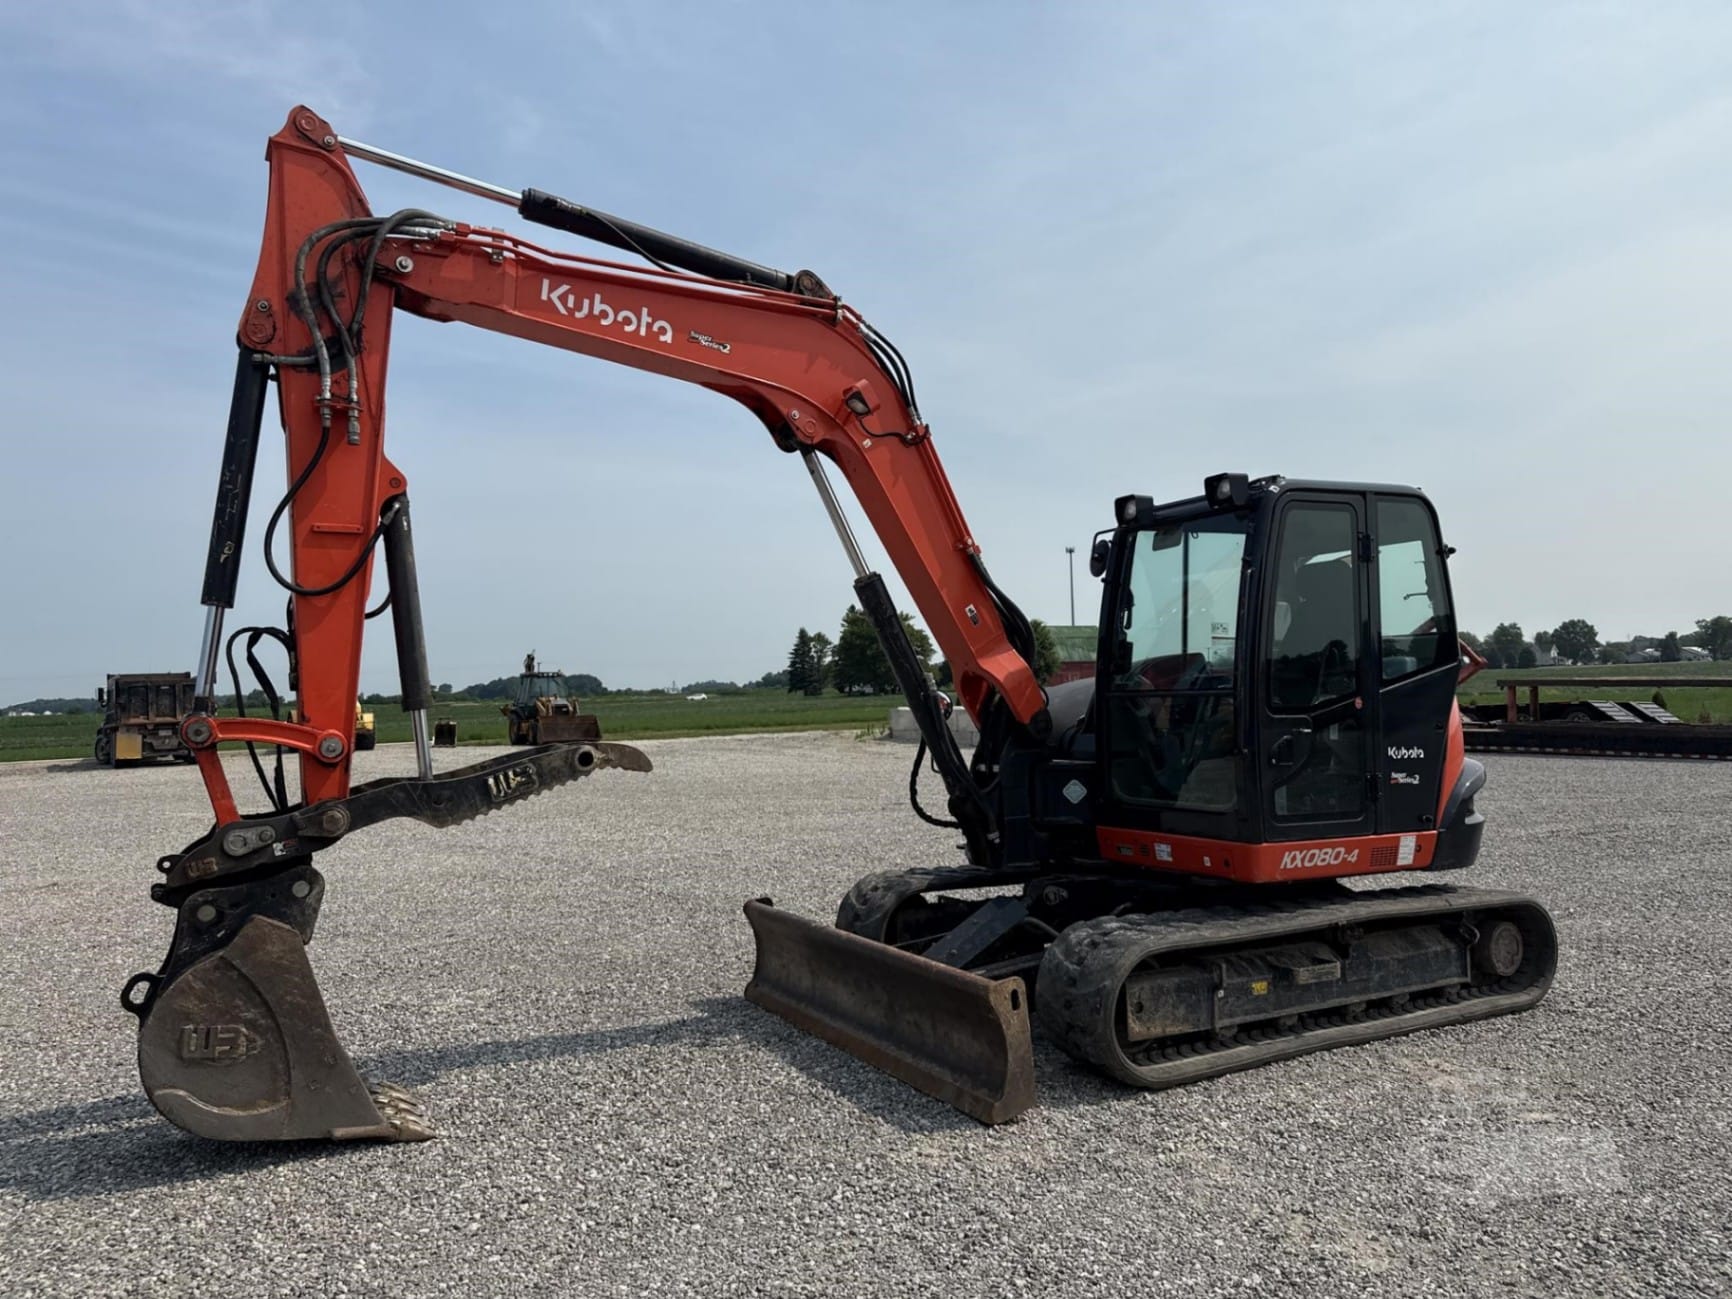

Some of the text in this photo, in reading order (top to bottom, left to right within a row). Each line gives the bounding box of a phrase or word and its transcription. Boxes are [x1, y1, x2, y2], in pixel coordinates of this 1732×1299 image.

[540, 278, 673, 344] Kubota
[1387, 746, 1425, 759] Kubota
[1280, 847, 1360, 869] KX080-4
